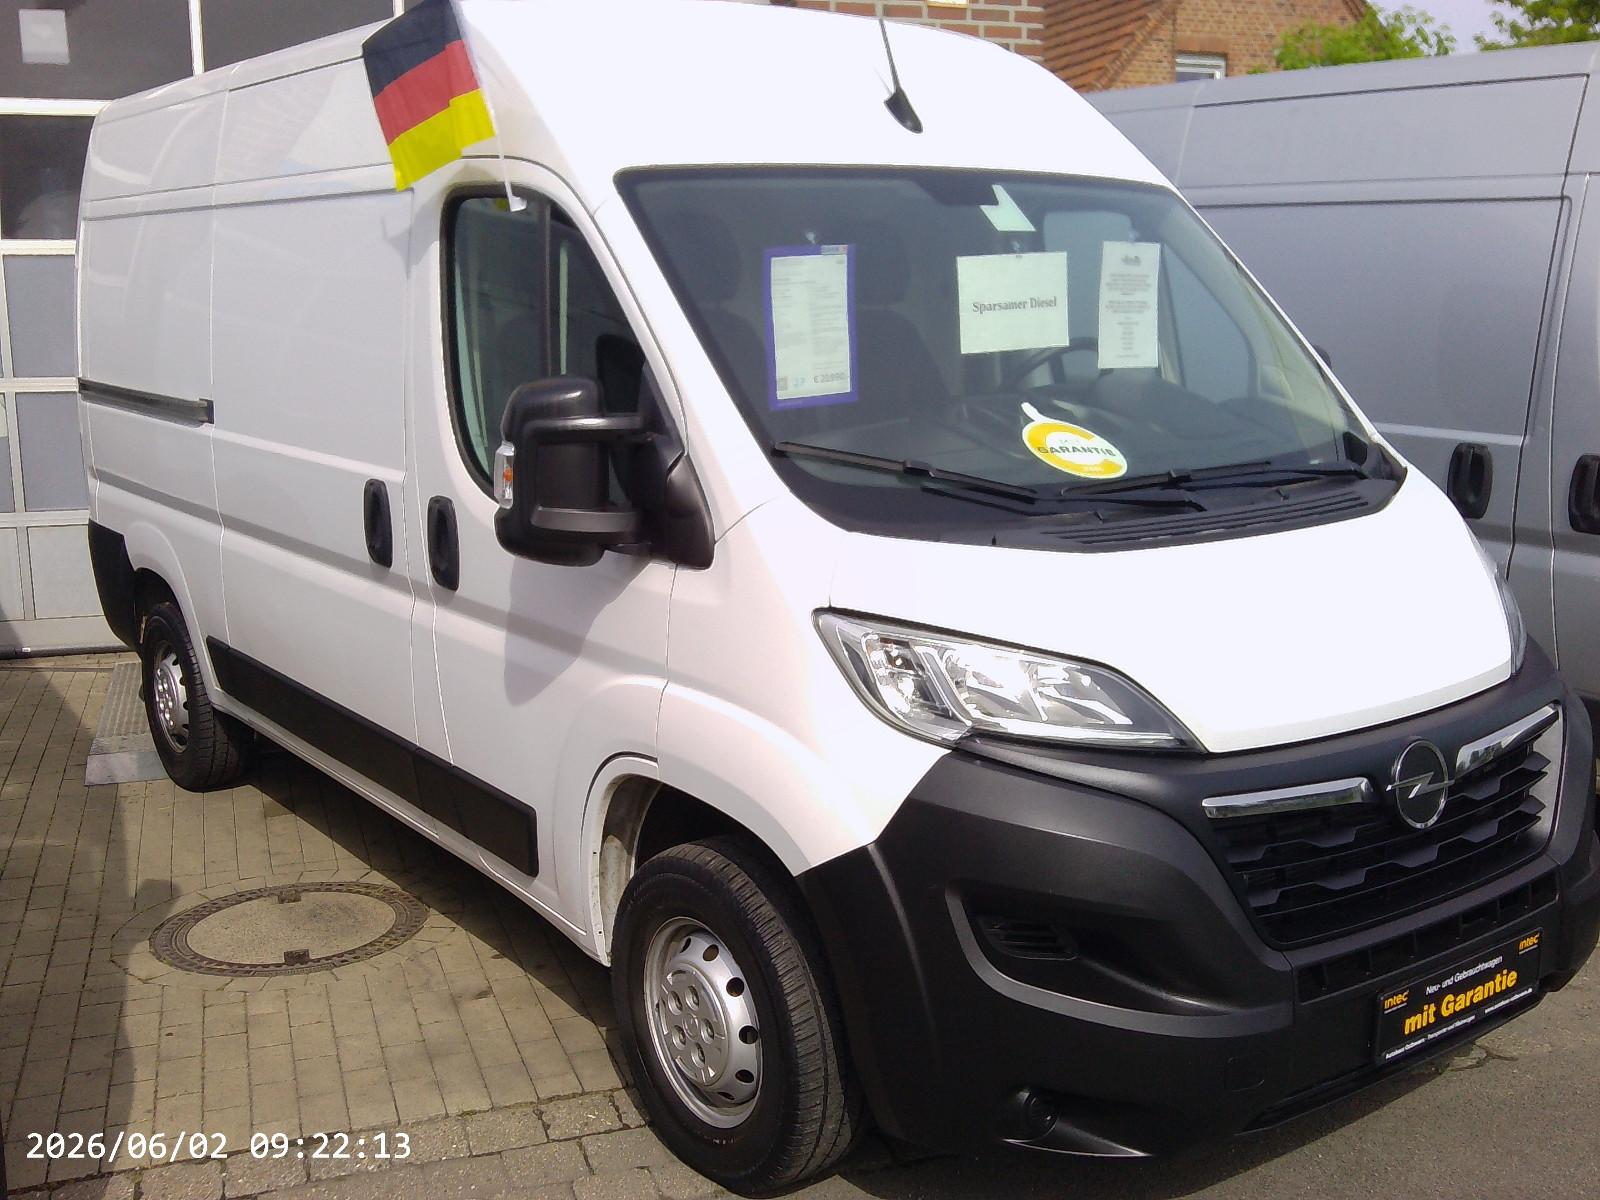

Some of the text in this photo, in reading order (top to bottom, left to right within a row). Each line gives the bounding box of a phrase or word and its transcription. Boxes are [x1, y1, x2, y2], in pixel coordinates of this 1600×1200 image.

[973, 295, 1057, 315] Sparsamer Diesel
[1037, 445, 1116, 457] GARANTIE
[1442, 975, 1453, 988] und
[1454, 956, 1503, 983] Gebrauchtwagen
[1404, 1003, 1437, 1035] mit
[1441, 969, 1518, 1017] Garantie
